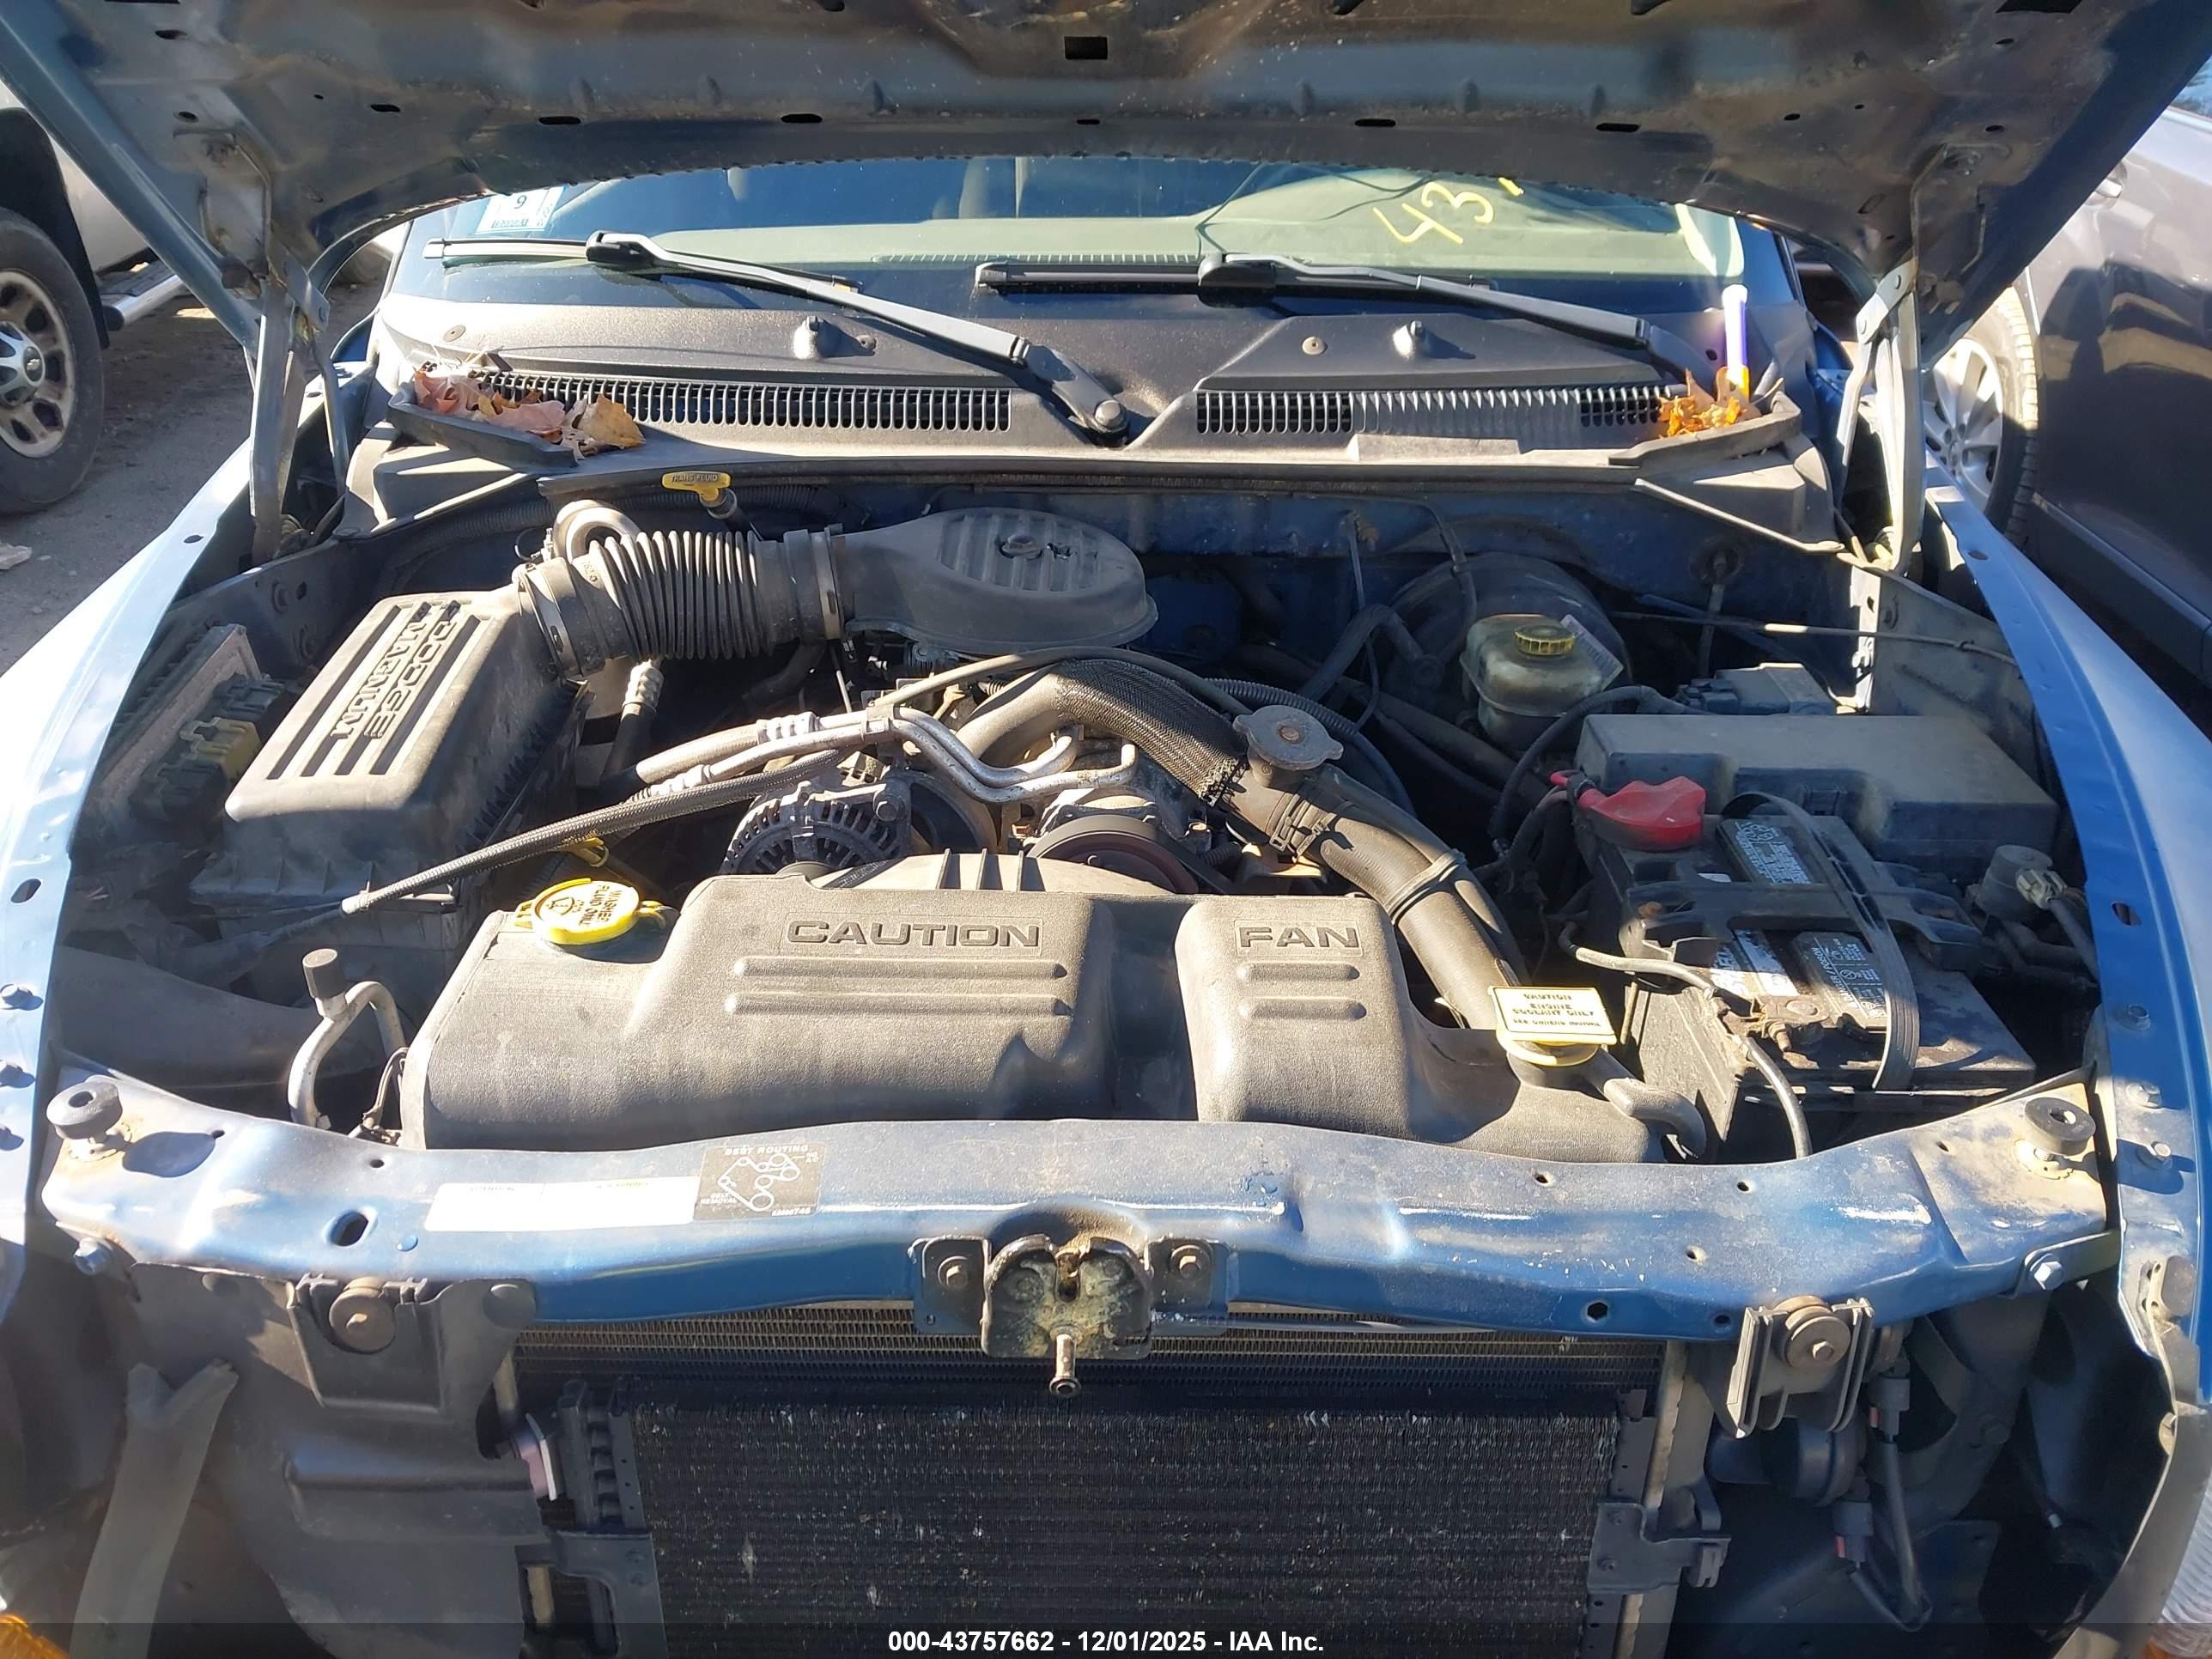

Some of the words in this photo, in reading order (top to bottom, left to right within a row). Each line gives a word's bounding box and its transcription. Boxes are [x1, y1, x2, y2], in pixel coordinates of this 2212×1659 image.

[514, 194, 528, 210] 9
[1372, 177, 1524, 244] 43
[696, 473, 718, 482] FLUID
[331, 621, 428, 740] MAGNUM
[364, 620, 459, 739] DODGE
[787, 920, 1041, 947] CAUTION
[1239, 927, 1359, 948] FAN
[757, 1144, 809, 1154] ROUTING
